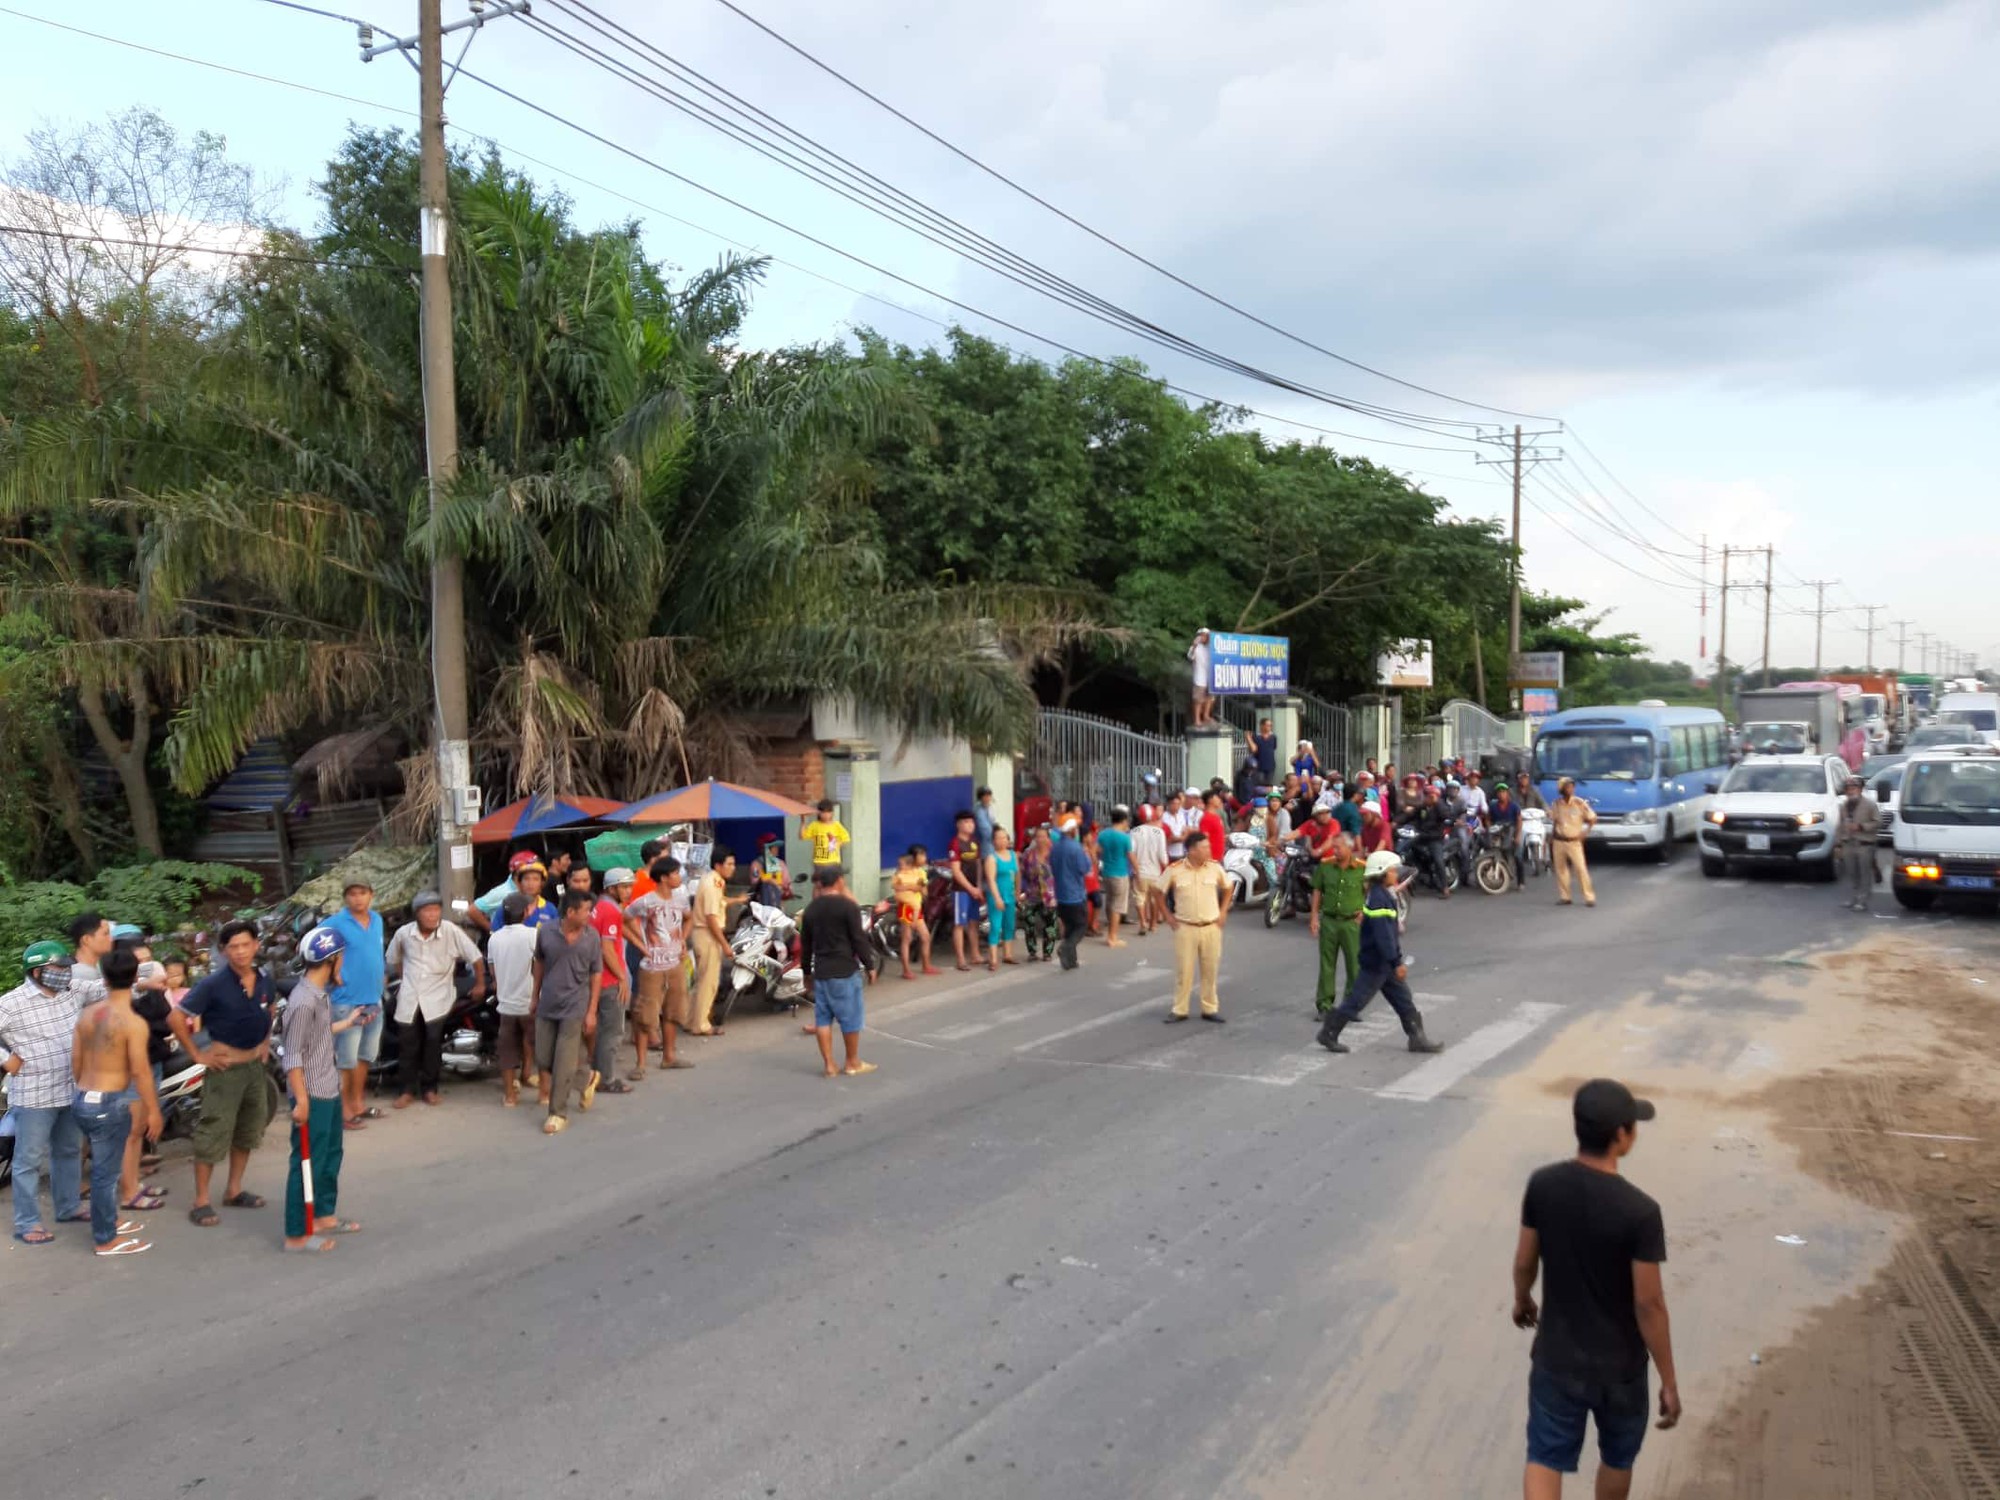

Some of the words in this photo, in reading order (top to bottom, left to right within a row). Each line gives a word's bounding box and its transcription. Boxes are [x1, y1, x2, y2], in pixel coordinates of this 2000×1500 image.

[1214, 634, 1238, 654] Quán
[1214, 658, 1238, 688] BÚN
[1240, 664, 1262, 692] MỌC
